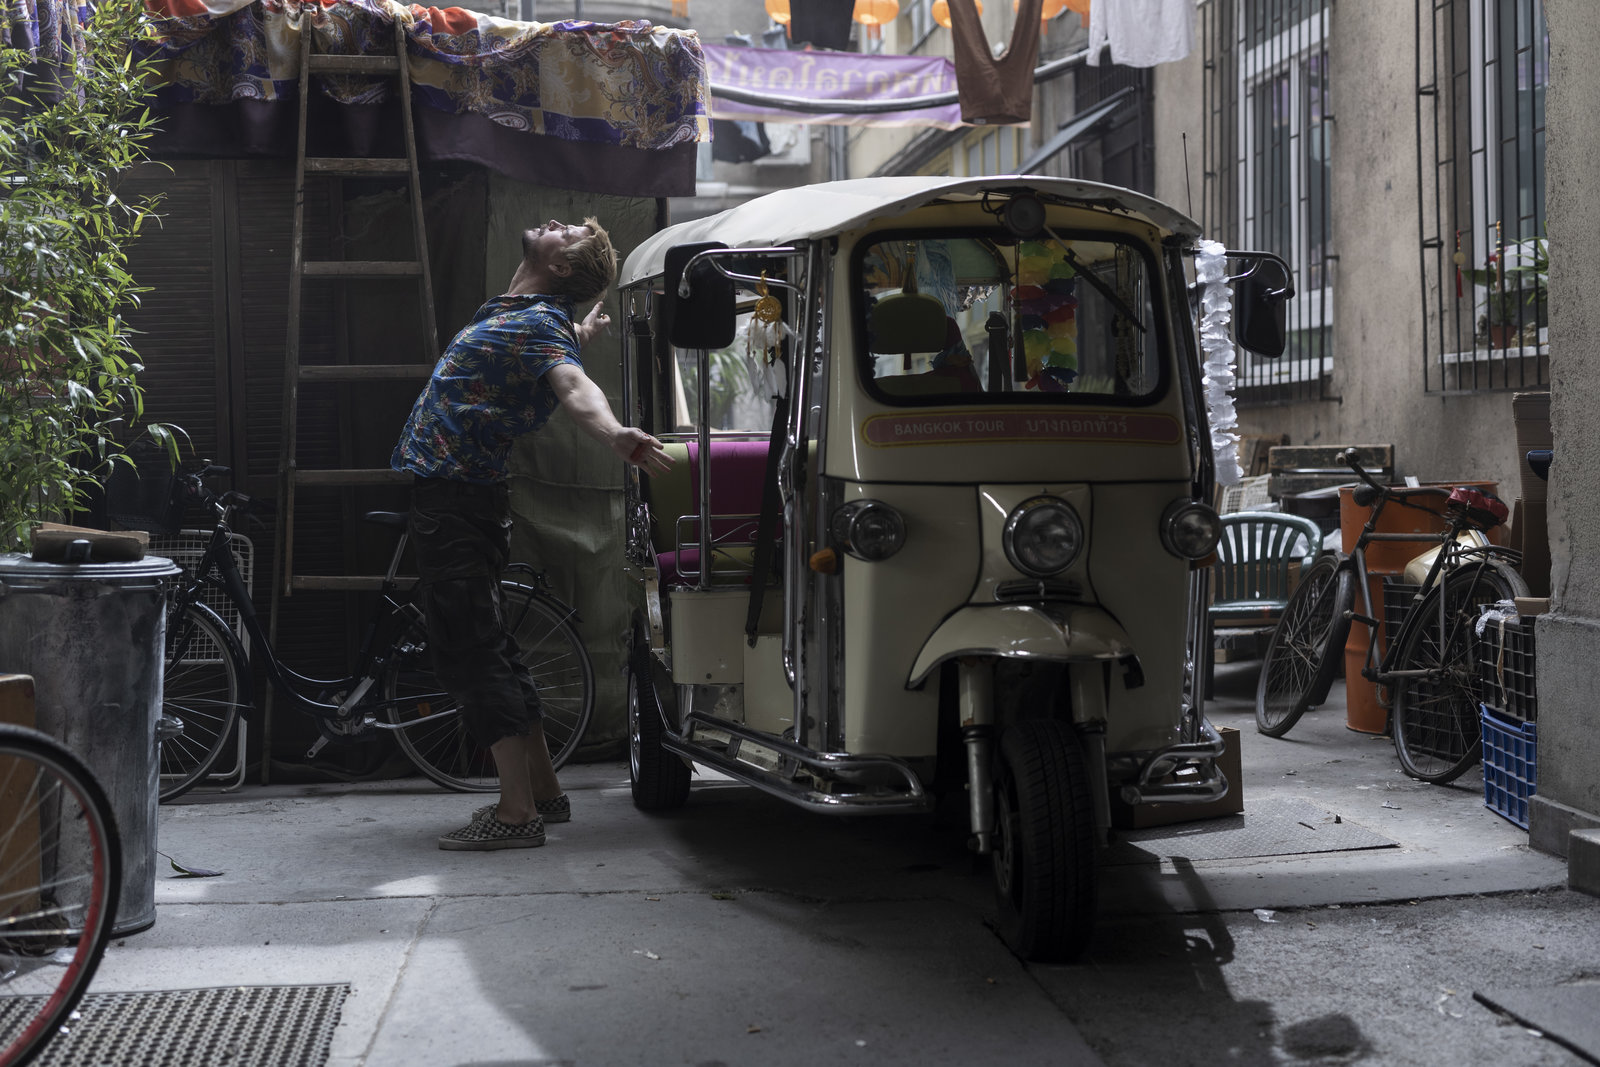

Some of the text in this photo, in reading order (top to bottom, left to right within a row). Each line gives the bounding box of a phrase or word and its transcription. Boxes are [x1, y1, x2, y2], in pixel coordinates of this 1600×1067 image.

[894, 419, 1005, 436] BANGKOK TOUR
[1026, 414, 1128, 434] บางกอกทัวร์
